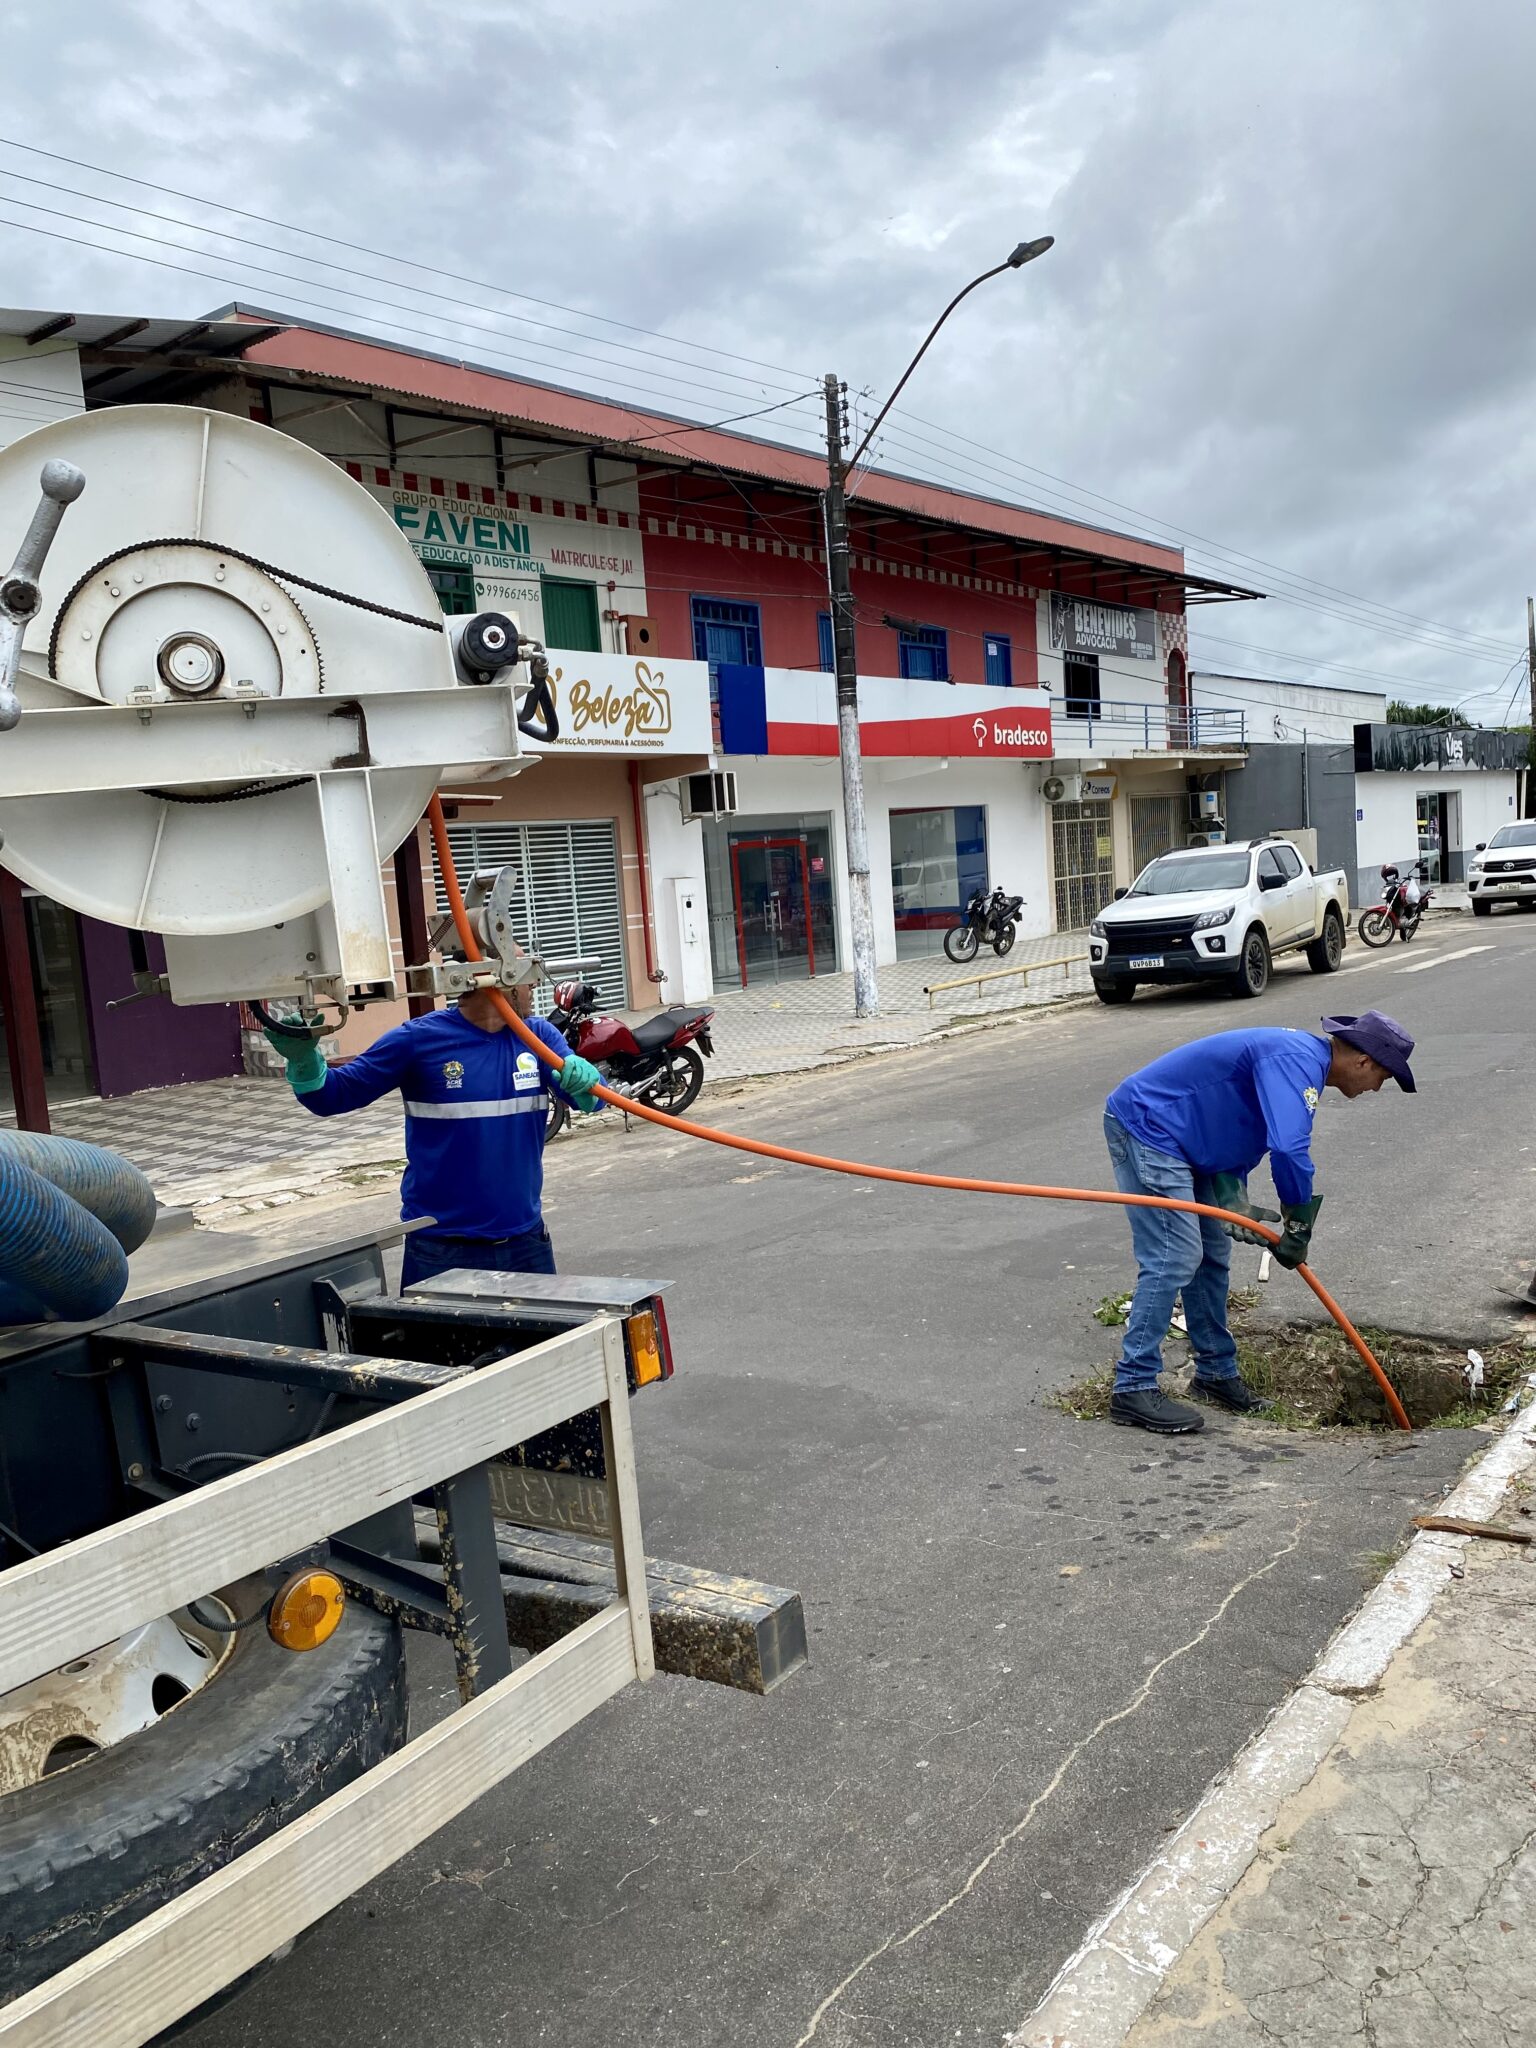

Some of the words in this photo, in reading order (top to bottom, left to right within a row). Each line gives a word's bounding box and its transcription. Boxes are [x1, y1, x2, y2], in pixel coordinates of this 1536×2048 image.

[393, 491, 436, 508] GRUPO
[443, 500, 522, 523] EDUCACIONAL
[394, 504, 531, 554] FAVENI
[422, 546, 481, 564] EDUCAÇÃO
[484, 555, 492, 566] A
[493, 557, 546, 574] DISTÂNCIA
[551, 548, 619, 572] MATRICULE-SE
[486, 584, 540, 602] 999661456
[1074, 602, 1137, 640] BENEVIDES
[1076, 633, 1118, 650] ADVOCACIA
[569, 679, 655, 737] Beleza
[548, 736, 587, 746] ONFECÇÃO,
[994, 722, 1048, 746] bradesco
